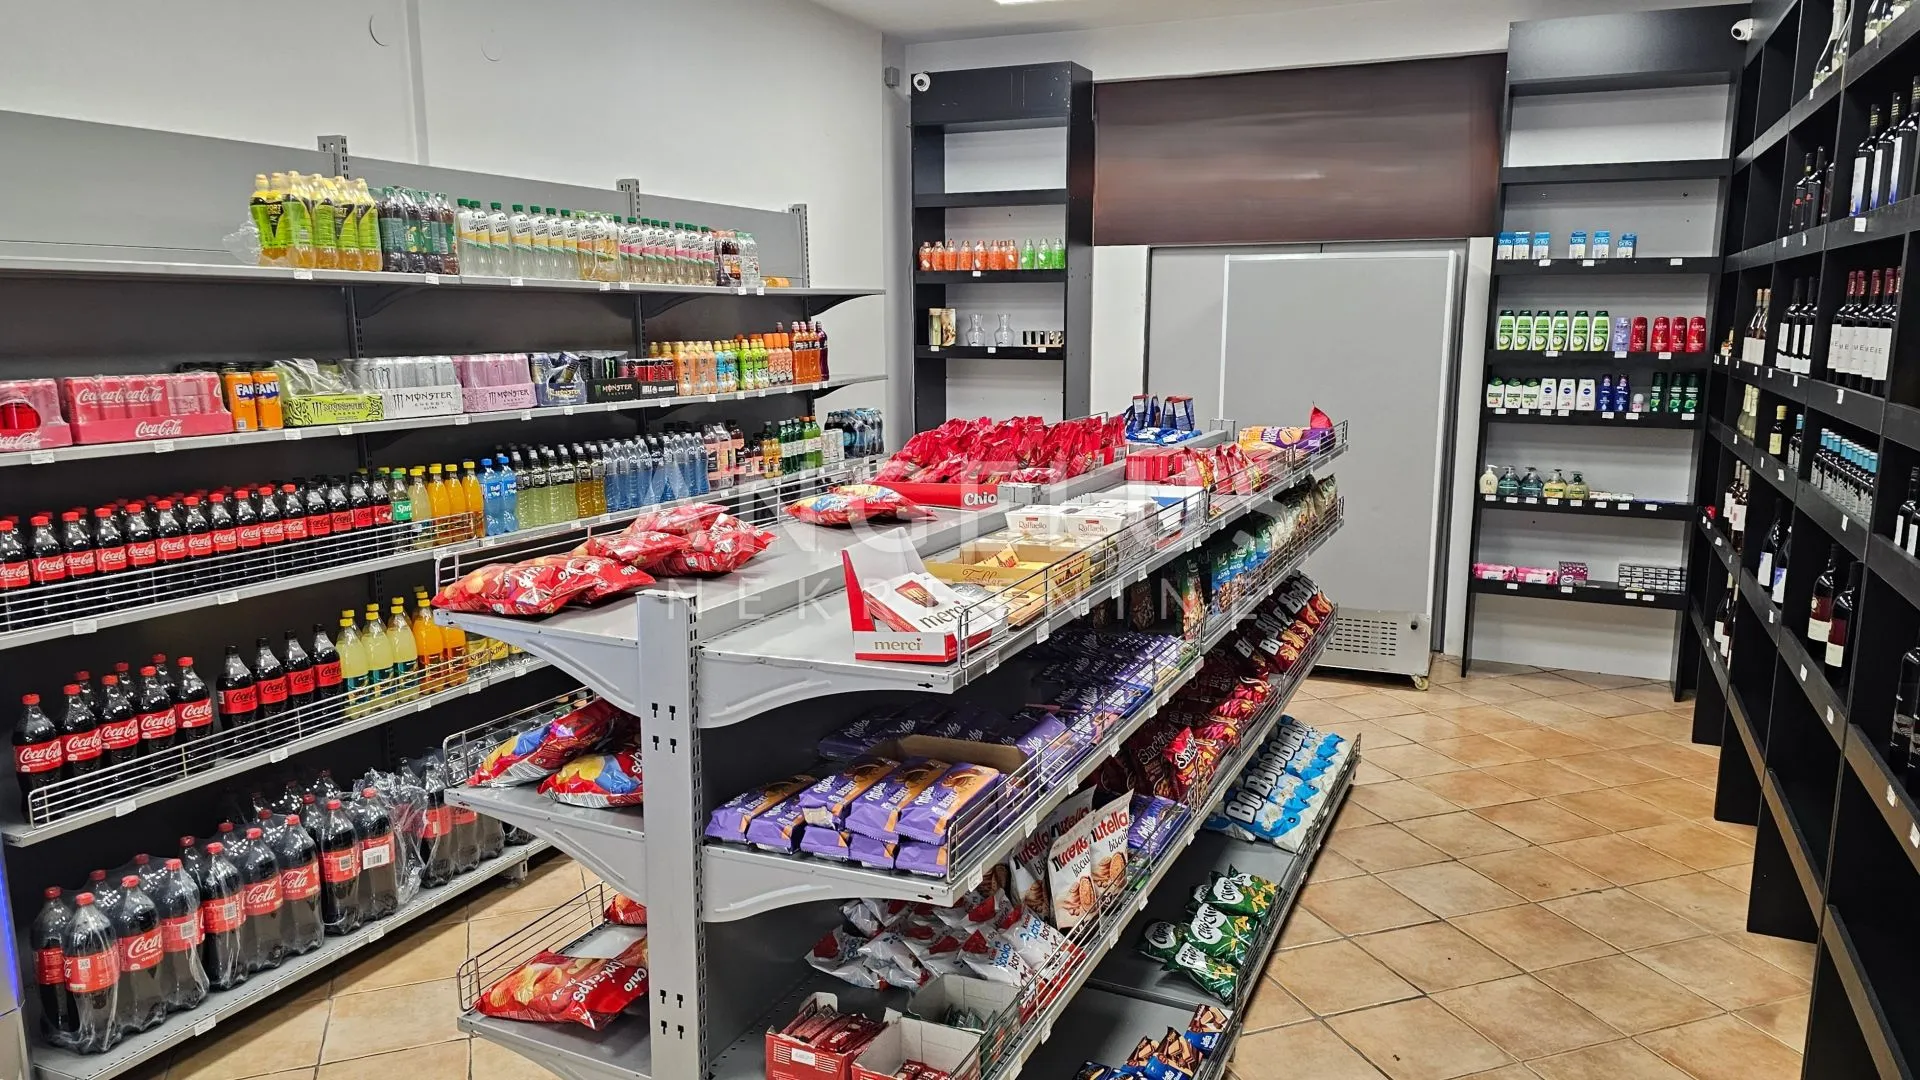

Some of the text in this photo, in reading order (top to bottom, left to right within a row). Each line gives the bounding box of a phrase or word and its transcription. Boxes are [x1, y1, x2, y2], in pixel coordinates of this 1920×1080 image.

[236, 382, 254, 396] FAN
[255, 382, 280, 395] FANT
[497, 389, 530, 399] MONSTER
[602, 383, 634, 392] MONSTER
[405, 391, 453, 402] MONSTER
[136, 419, 183, 438] Coca-Cola
[962, 491, 998, 507] Chio
[396, 503, 412, 515] Spri
[1018, 520, 1047, 529] Raffaello
[1078, 523, 1109, 532] Raffaello
[620, 565, 638, 576] Chio
[874, 638, 922, 651] merci
[813, 775, 836, 793] Milka
[865, 782, 887, 801] Milka
[915, 786, 935, 806] Milka
[1091, 810, 1129, 843] nutella
[1108, 828, 1129, 852] biscuit
[1012, 831, 1050, 870] nutella
[623, 967, 648, 992] Chio
